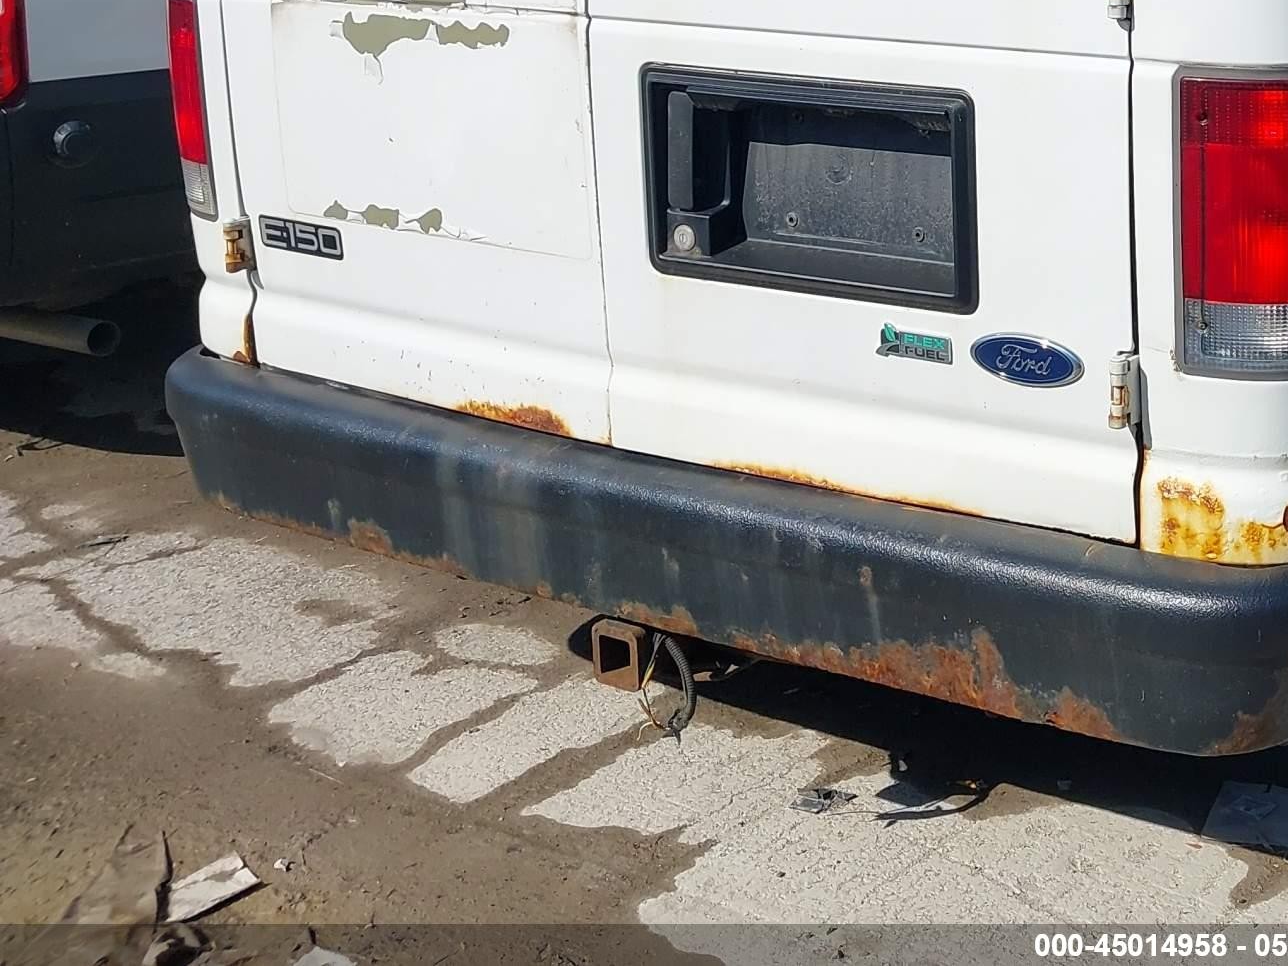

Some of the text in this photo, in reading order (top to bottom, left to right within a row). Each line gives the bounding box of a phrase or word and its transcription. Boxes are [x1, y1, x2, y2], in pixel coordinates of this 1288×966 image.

[903, 333, 945, 350] FLEX
[904, 345, 948, 362] FUEL
[996, 344, 1053, 376] Ford
